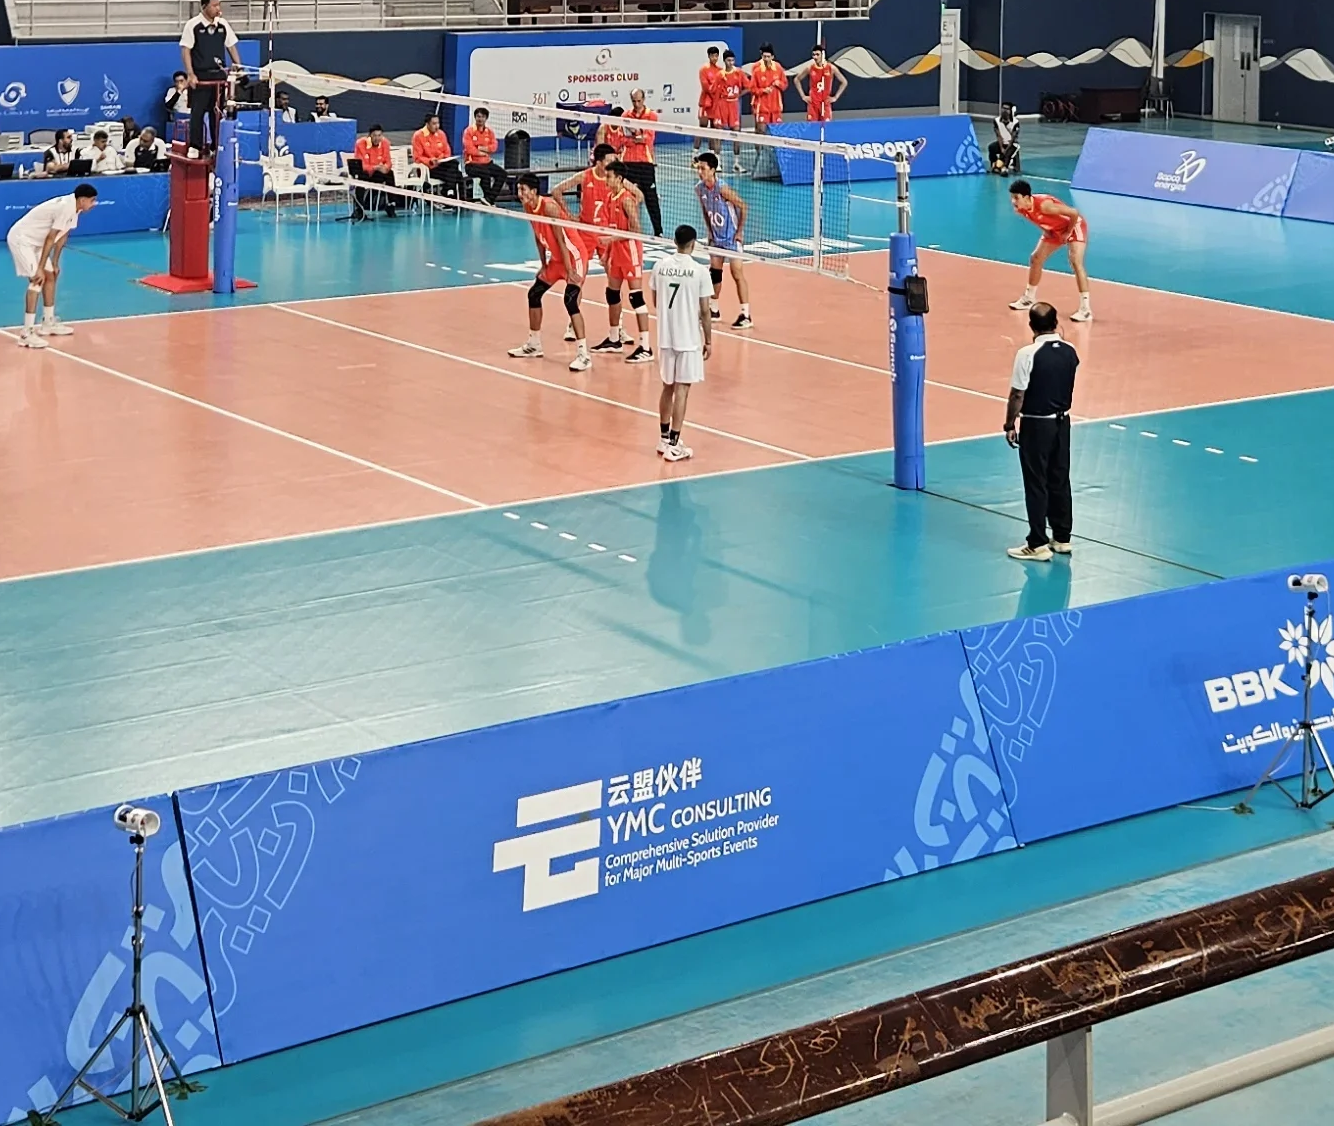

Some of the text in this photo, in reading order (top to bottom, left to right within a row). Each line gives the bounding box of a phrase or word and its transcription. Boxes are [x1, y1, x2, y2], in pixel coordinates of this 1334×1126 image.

[567, 73, 639, 84] SPONSORS CLUB
[1154, 181, 1186, 192] energies
[668, 282, 680, 309] 7
[1204, 663, 1300, 713] BBK
[607, 757, 703, 808] 云盟伙伴
[607, 786, 772, 845] YMC CONSULTING
[604, 836, 759, 887] for Major Multi-Sports Events
[605, 813, 780, 869] Comprehensive Solution Provider
